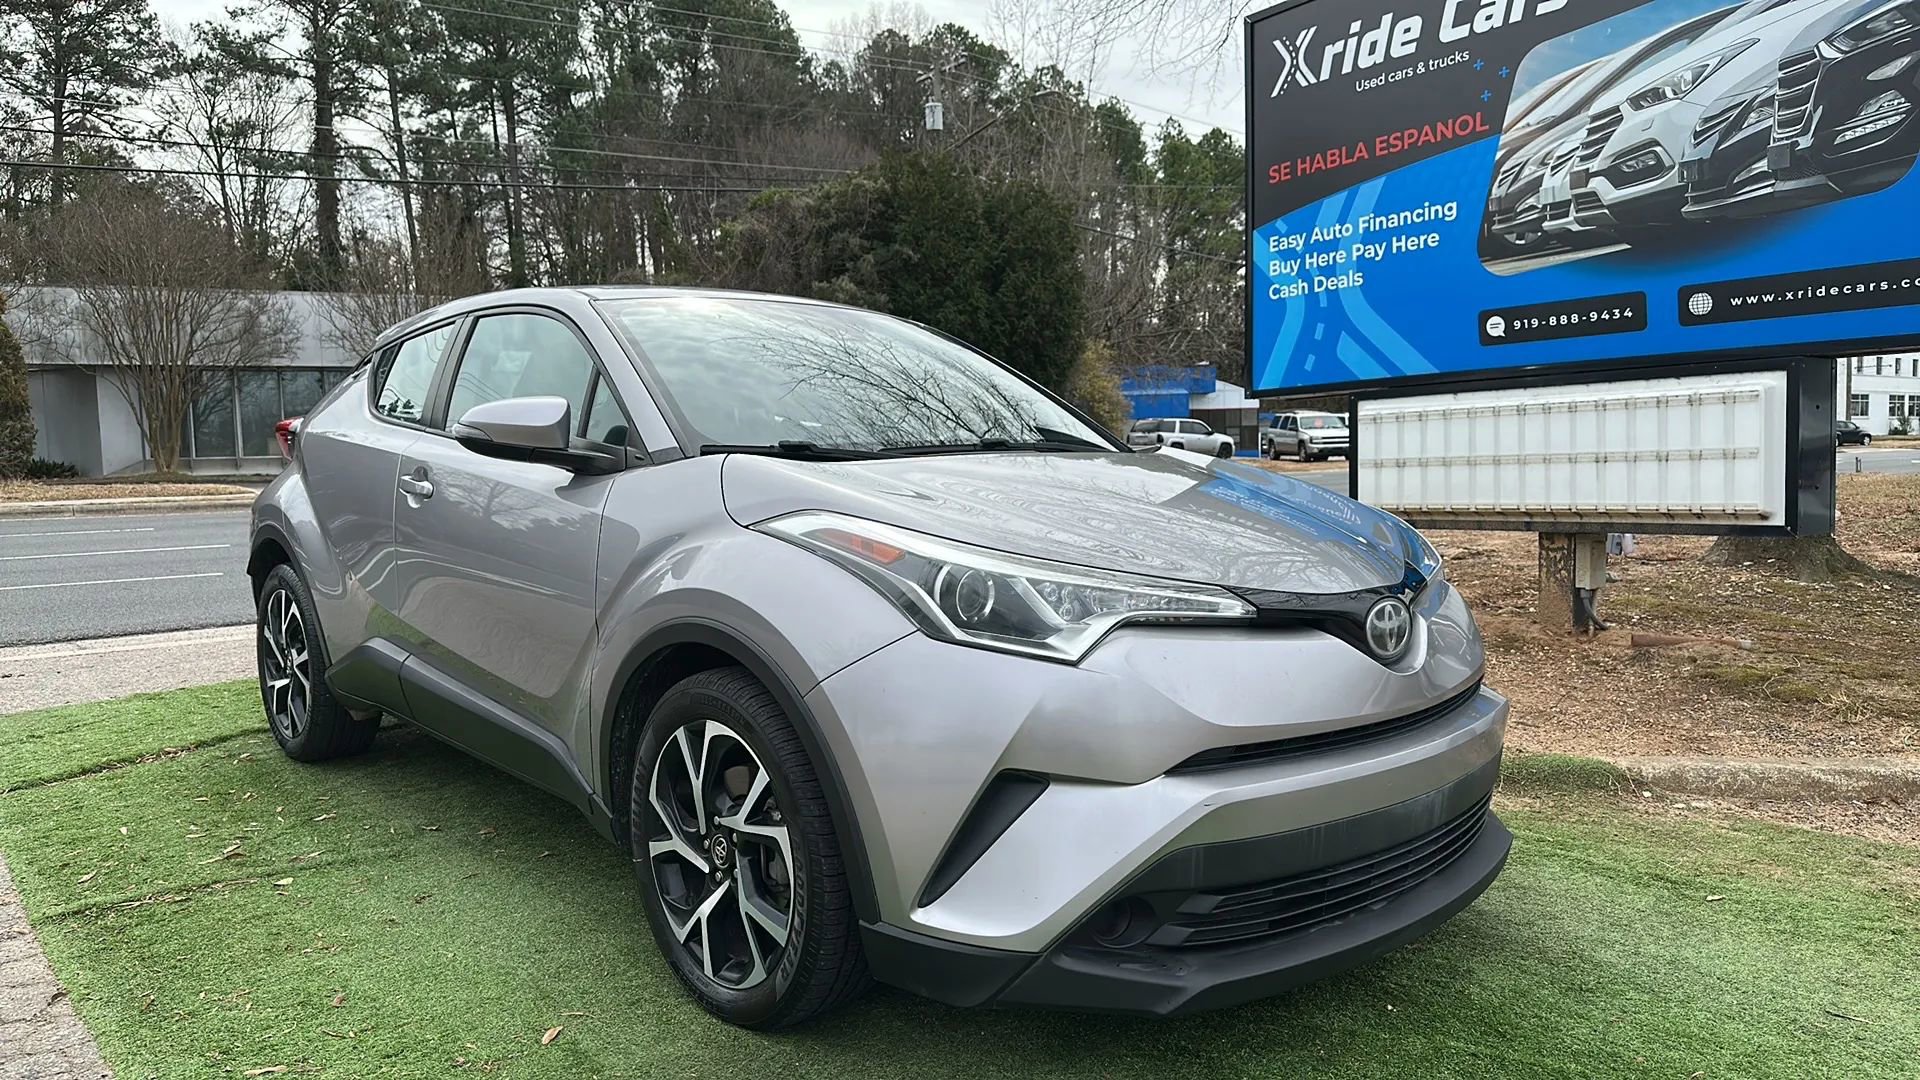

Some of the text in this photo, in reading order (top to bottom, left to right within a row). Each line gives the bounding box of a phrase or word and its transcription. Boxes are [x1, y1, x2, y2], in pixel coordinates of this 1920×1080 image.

[1270, 12, 1423, 97] Xride
[1355, 50, 1470, 92] Used cars & trucks
[1268, 111, 1490, 184] SE HABLA ESPANOL
[1269, 201, 1458, 253] Easy Auto Financing
[1269, 232, 1440, 277] Buy Here Pay Here
[1269, 270, 1364, 300] Cash Deals
[1513, 307, 1634, 330] 919-888-9434
